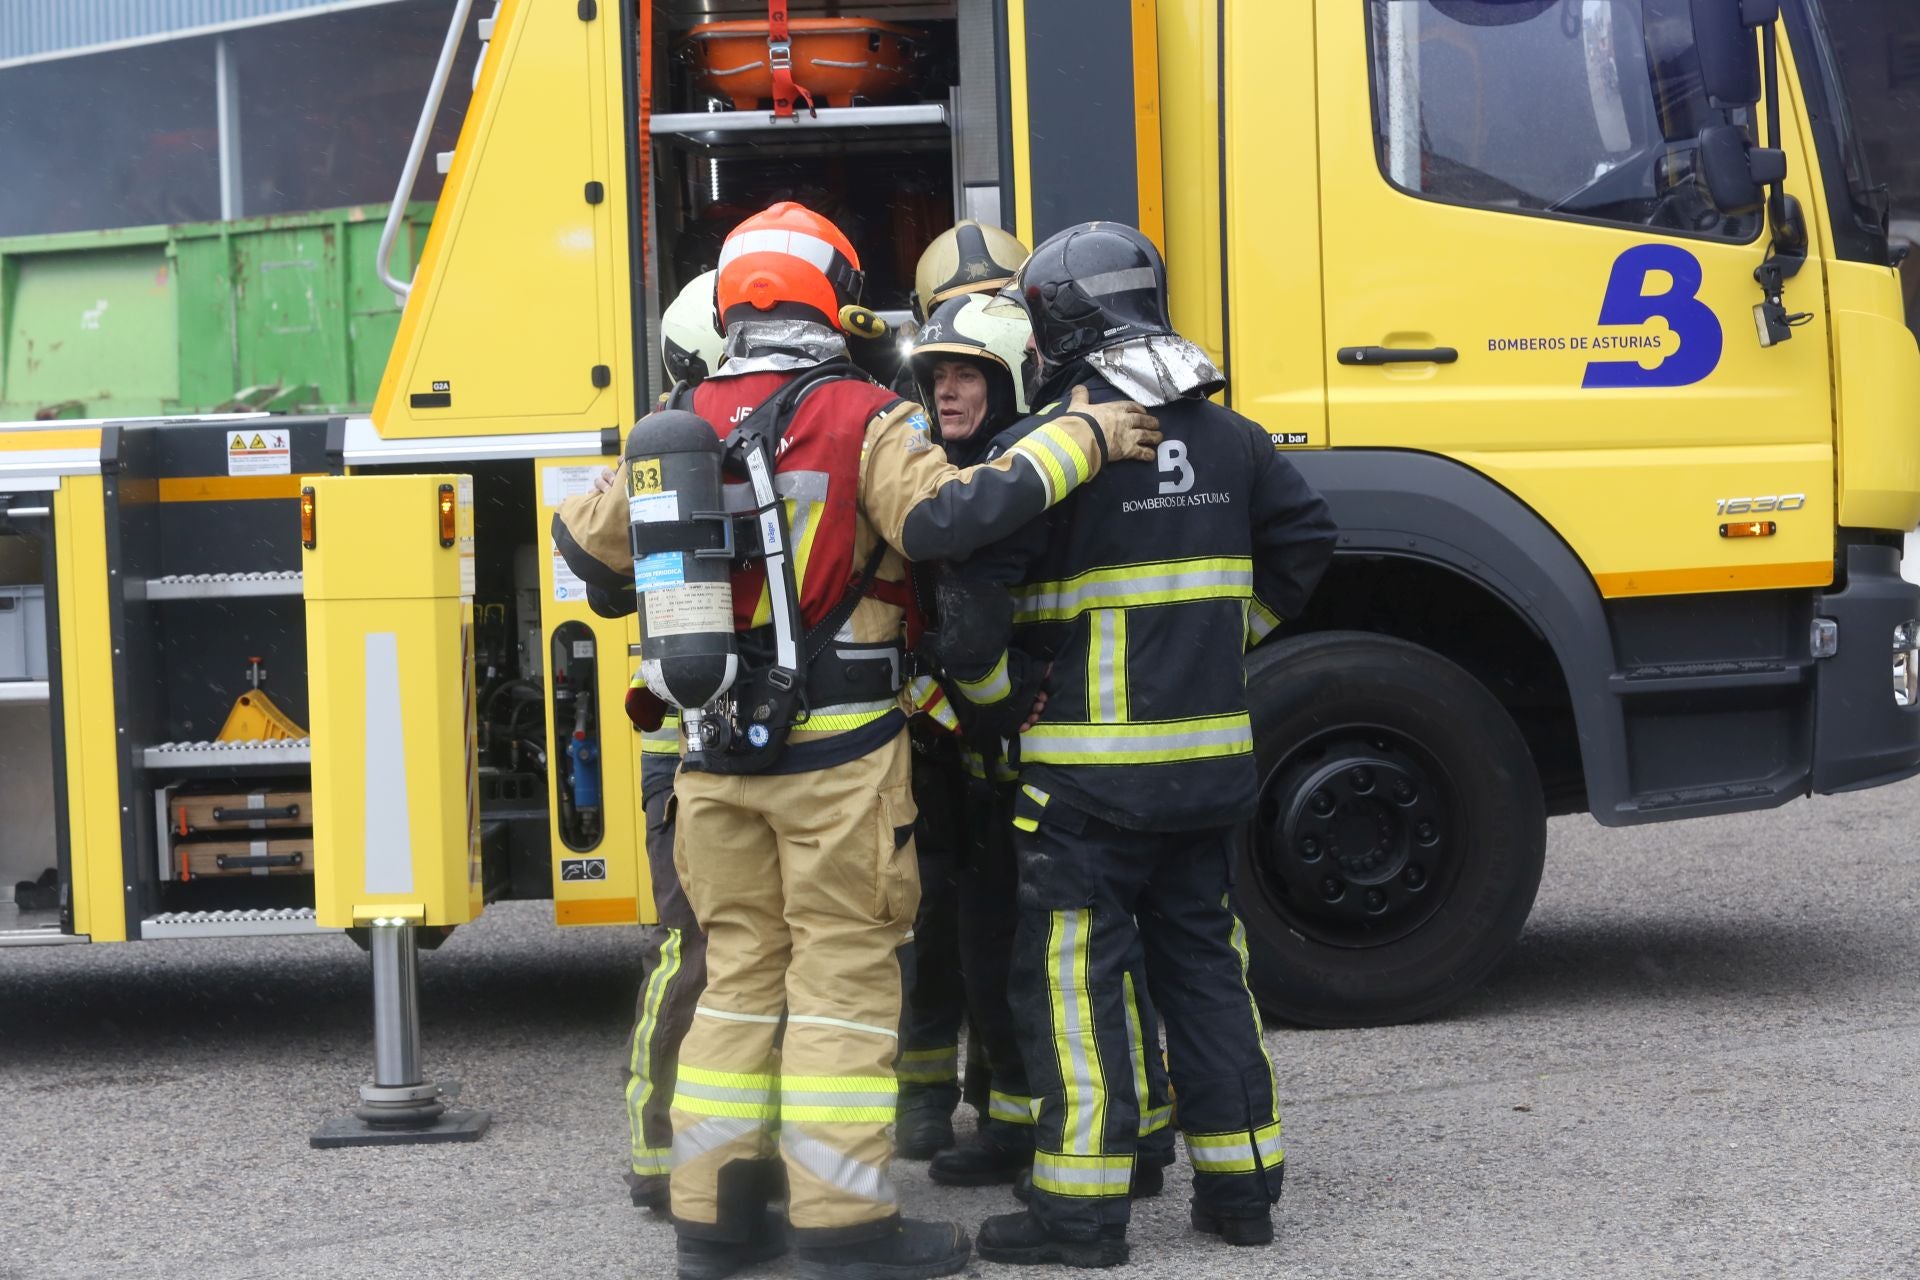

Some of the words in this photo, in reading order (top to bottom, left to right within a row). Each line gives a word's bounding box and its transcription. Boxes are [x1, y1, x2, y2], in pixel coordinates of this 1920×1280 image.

[1581, 243, 1723, 389] B
[1488, 337, 1566, 351] BOMBEROS
[1570, 337, 1588, 349] DE
[1592, 335, 1661, 349] ASTURIAS
[433, 382, 449, 391] G2A
[1271, 433, 1284, 444] 00
[1288, 433, 1306, 444] bar
[1157, 440, 1194, 494] B
[634, 468, 659, 490] 83
[1123, 497, 1176, 512] BOMBEROS
[1176, 496, 1186, 506] DE
[1187, 492, 1230, 506] ASTURIAS
[1717, 493, 1805, 515] 1630
